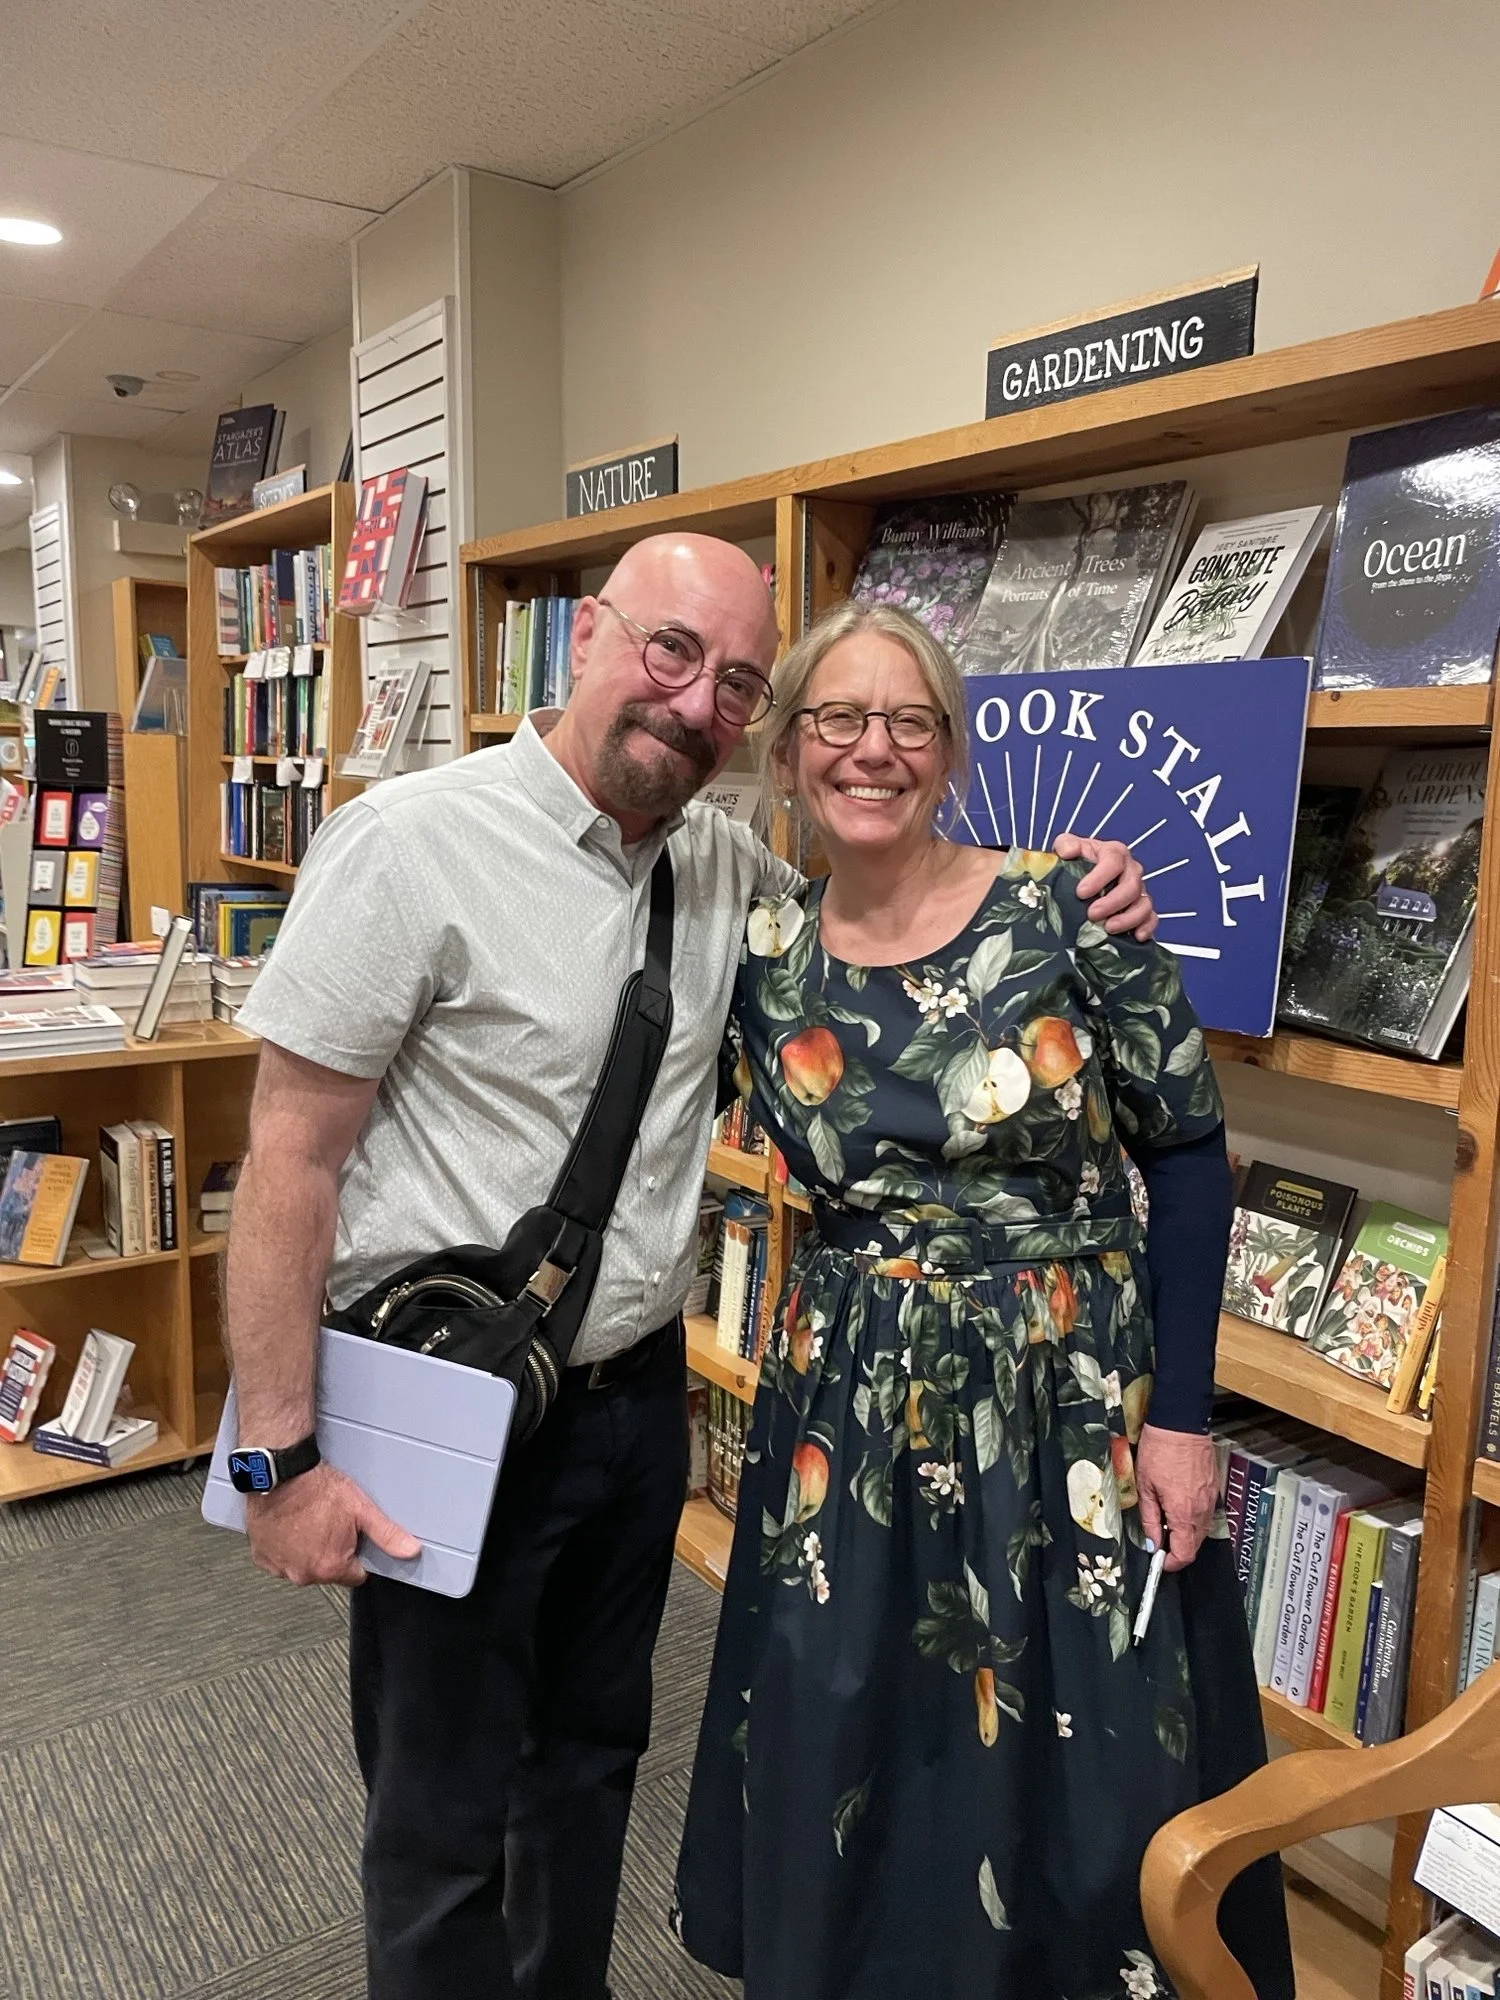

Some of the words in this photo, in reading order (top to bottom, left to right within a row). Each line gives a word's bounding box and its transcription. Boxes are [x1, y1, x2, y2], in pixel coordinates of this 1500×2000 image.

[1002, 316, 1205, 401] GARDENING
[217, 426, 264, 444] STARGAZER'S
[213, 436, 262, 462] ATLAS
[578, 456, 658, 515] NATURE
[881, 527, 924, 544] Bunny
[927, 521, 988, 541] Williams
[1236, 534, 1280, 549] SANTORE
[1010, 560, 1072, 581] Ancient
[1083, 554, 1128, 575] Trees
[1187, 545, 1286, 585] CONCRETE
[1363, 533, 1466, 578] Ocean
[1002, 588, 1050, 603] Portraits
[1067, 582, 1082, 598] of
[1084, 582, 1118, 596] Time
[1162, 581, 1269, 631] Botany
[1406, 759, 1486, 783] GLORIOU
[704, 791, 740, 806] PLANTS
[975, 688, 1105, 743] OOK
[1118, 709, 1266, 927] STALL
[1397, 783, 1486, 805] GARDENS
[715, 804, 735, 817] NGI
[1269, 1188, 1324, 1211] POISONOUS
[1275, 1199, 1312, 1217] PLANTS
[1386, 1234, 1430, 1257] ORCHIDS
[1417, 1300, 1437, 1331] Tulips
[1488, 1382, 1500, 1436] BARTELS
[708, 1421, 740, 1451] HIDDEN
[725, 1419, 742, 1438] THE
[713, 1441, 725, 1456] OF
[1238, 1480, 1261, 1584] HYDRANGEAS
[1296, 1520, 1308, 1540] The
[1313, 1529, 1326, 1549] The
[1292, 1541, 1304, 1563] Cut
[1309, 1551, 1322, 1573] Cut
[1356, 1541, 1364, 1560] THE
[1285, 1564, 1302, 1601] Flower
[1326, 1562, 1339, 1598] TRADER
[1350, 1561, 1361, 1597] COOK'S
[1304, 1574, 1319, 1612] Flower
[1383, 1596, 1391, 1612] THE
[1280, 1603, 1296, 1646] Garden
[1321, 1597, 1334, 1625] JOE'S
[1345, 1597, 1357, 1634] GARDEN
[1297, 1614, 1313, 1656] Garden
[1315, 1624, 1331, 1671] FLOWERS
[1381, 1618, 1397, 1679] Gardenista
[1371, 1660, 1383, 1694] GARDEN
